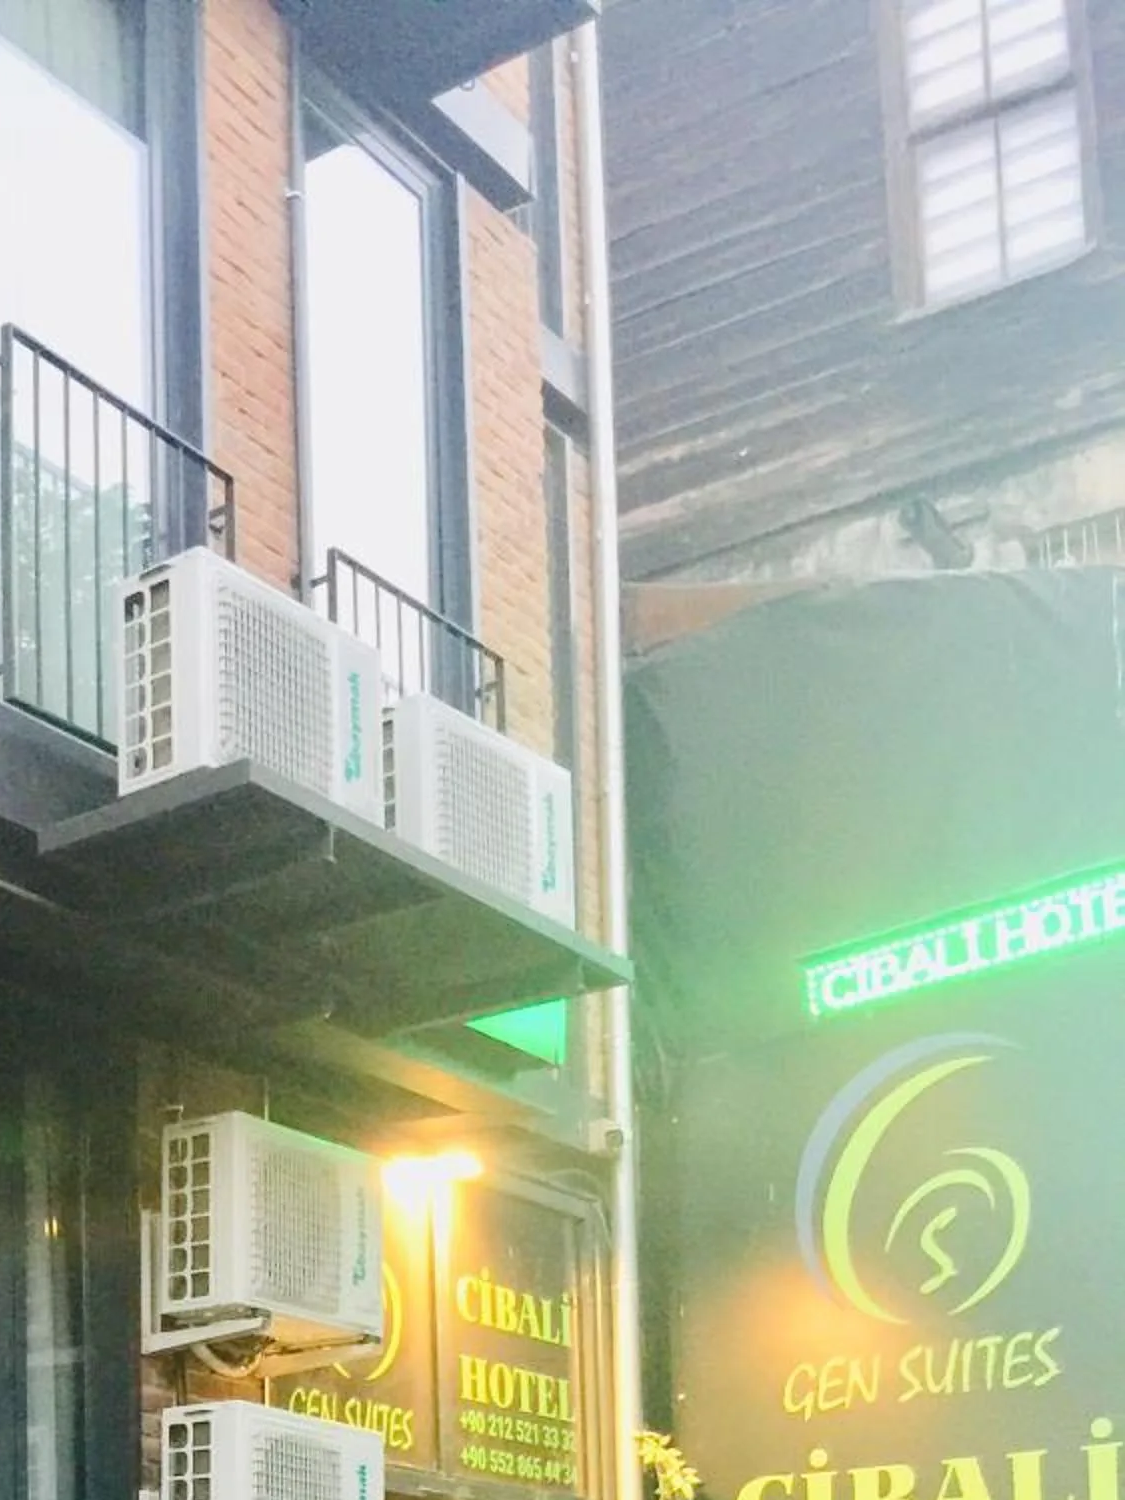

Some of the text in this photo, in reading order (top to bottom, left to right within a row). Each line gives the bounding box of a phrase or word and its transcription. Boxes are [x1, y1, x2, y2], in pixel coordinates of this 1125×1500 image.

[459, 1354, 575, 1422] HOTEL
[783, 1327, 1064, 1421] GEN SUITES
[487, 1413, 515, 1441] 212
